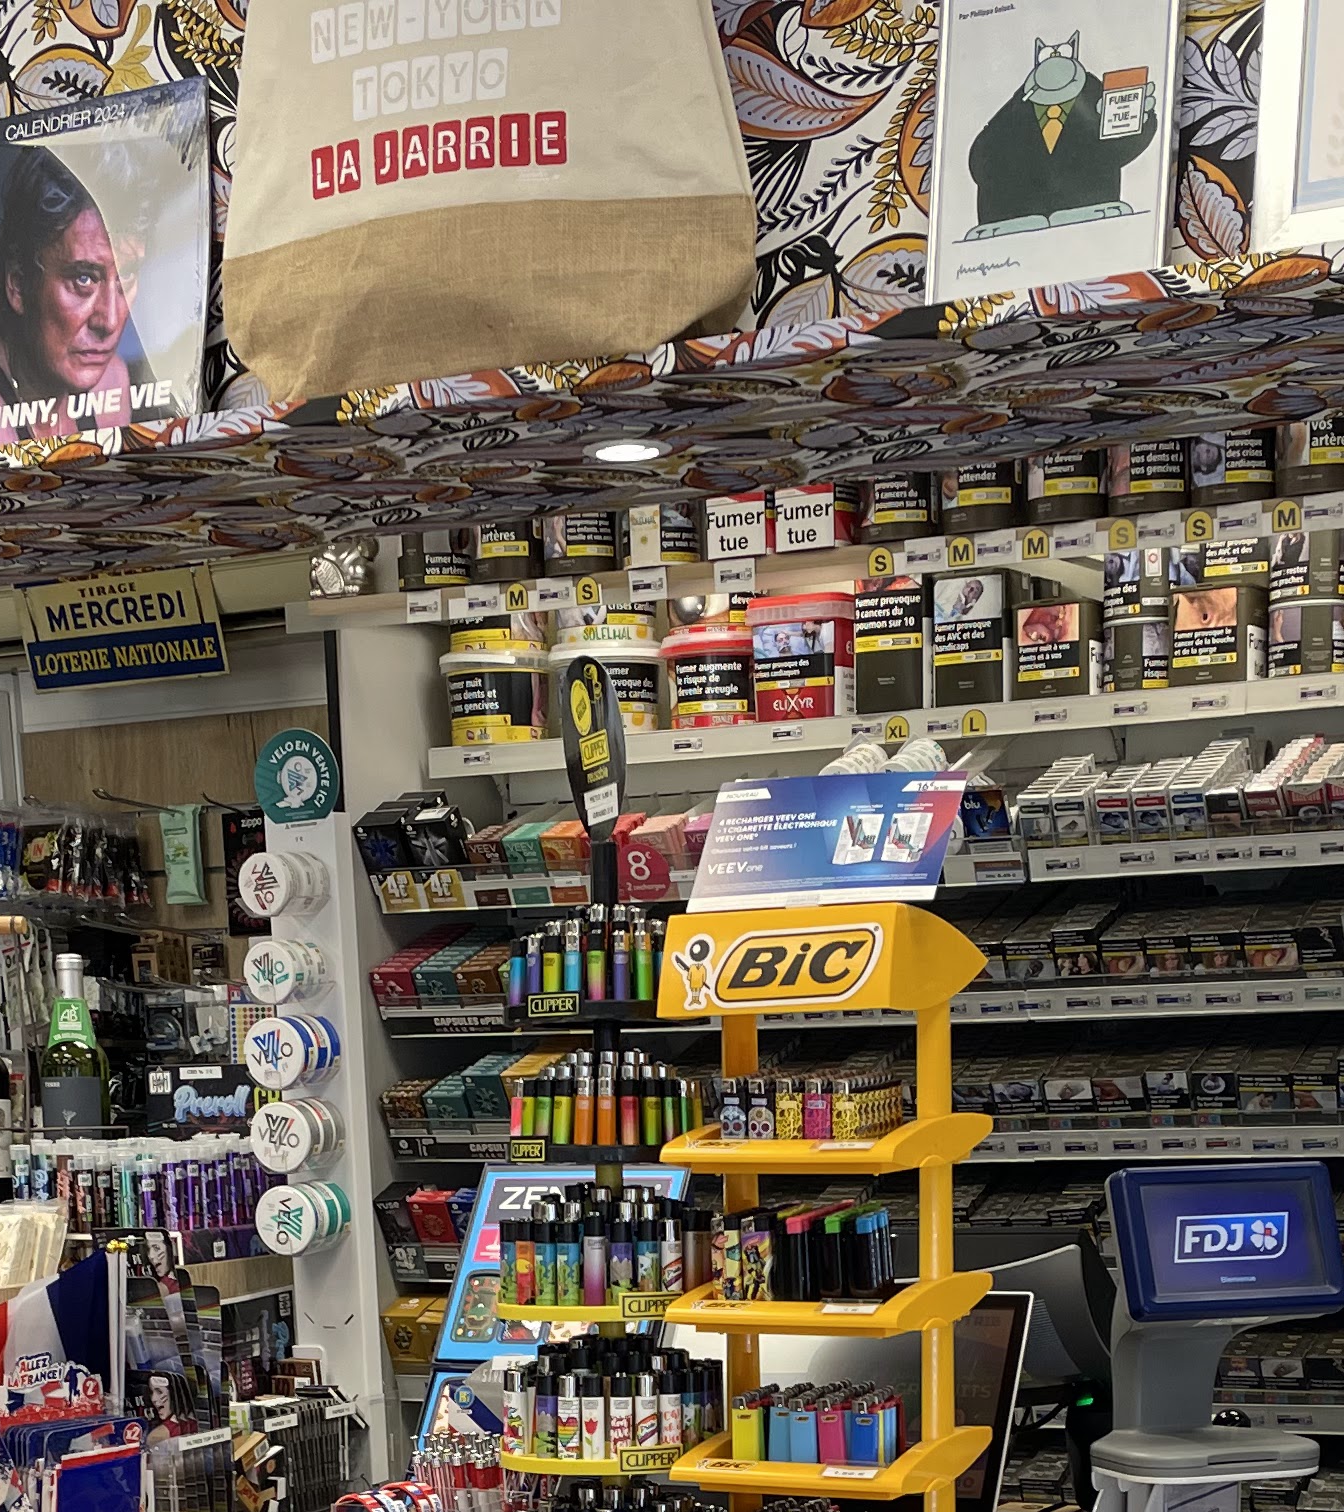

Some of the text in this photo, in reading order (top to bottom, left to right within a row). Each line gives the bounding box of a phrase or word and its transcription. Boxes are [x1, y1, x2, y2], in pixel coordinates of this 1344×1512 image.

[313, 0, 557, 54] NEW-YORK
[355, 58, 505, 111] TOKYO
[1109, 92, 1139, 105] FUMER
[5, 104, 126, 141] CALENDRIER 2024
[1113, 112, 1130, 121] TUE
[316, 121, 559, 190] LA JARRIE
[67, 386, 123, 419] UNE
[130, 380, 172, 409] VIE
[706, 509, 763, 530] Fumer
[775, 501, 833, 522] Fumer
[719, 534, 748, 551] tue
[787, 526, 817, 545] tue
[77, 582, 136, 598] TIRAGE
[45, 591, 186, 633] MERCREDI
[35, 637, 218, 677] LOTERIE NATIONALE
[295, 739, 309, 752] EN
[581, 737, 609, 768] CLIPPER
[311, 747, 330, 788] VENTE
[314, 789, 326, 807] ICI
[241, 817, 263, 829] zippo
[531, 997, 577, 1015] CLIPPER
[173, 1085, 251, 1122] Preroll
[1183, 1223, 1245, 1253] FDJ
[624, 1448, 679, 1470] CLIPPER
